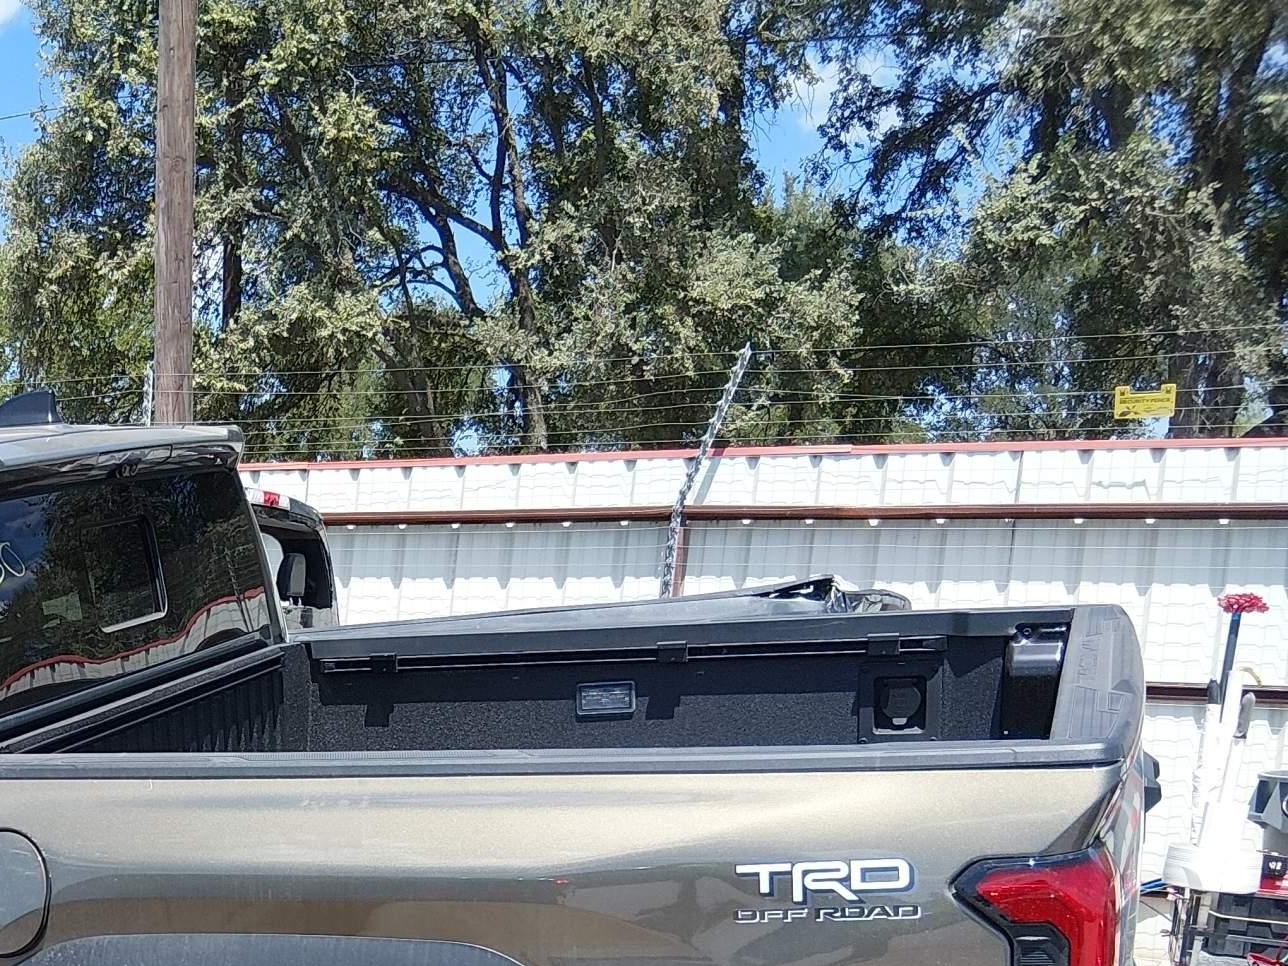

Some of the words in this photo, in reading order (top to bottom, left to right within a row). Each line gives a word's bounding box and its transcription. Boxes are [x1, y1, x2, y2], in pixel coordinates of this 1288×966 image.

[734, 858, 916, 905] TRD
[734, 907, 809, 924] OFF
[814, 904, 922, 923] ROAD
